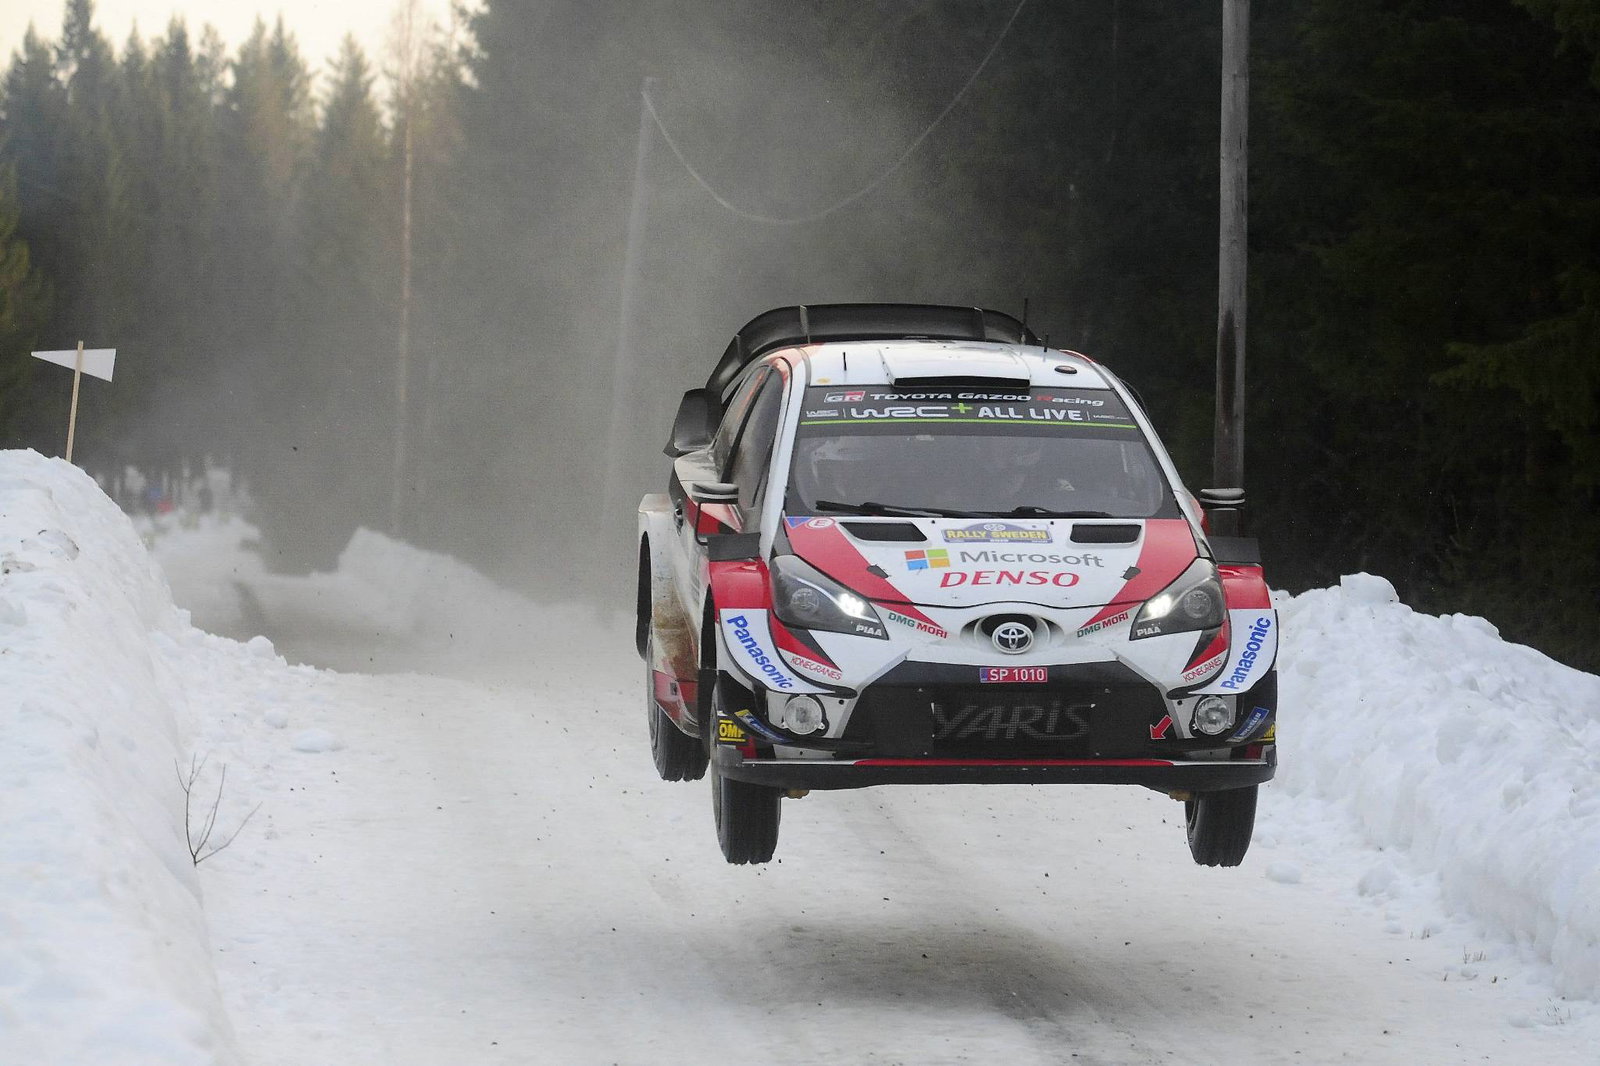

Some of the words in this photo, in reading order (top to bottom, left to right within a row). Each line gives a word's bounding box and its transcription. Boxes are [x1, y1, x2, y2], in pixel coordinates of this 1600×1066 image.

[825, 393, 861, 402] GR
[957, 392, 1032, 401] GAZOO
[1036, 394, 1104, 407] Racing
[977, 406, 1024, 419] ALL
[1029, 407, 1083, 421] LIVE
[945, 529, 987, 539] RALLY
[990, 530, 1048, 540] SWEDEN
[959, 550, 1105, 568] Microsoft
[940, 570, 1080, 588] DENSO
[855, 624, 883, 637] PIAA
[887, 612, 915, 628] DMG
[916, 621, 948, 639] MORI
[1076, 622, 1101, 638] DMG
[1101, 611, 1129, 629] MORI
[1136, 626, 1162, 637] PIAA
[726, 615, 793, 689] Panasonic
[1220, 617, 1271, 690] Panasonic
[790, 655, 843, 680] KONECRANES
[989, 668, 1009, 681] SP
[1012, 668, 1045, 681] 1010
[930, 701, 1096, 741] YARIS
